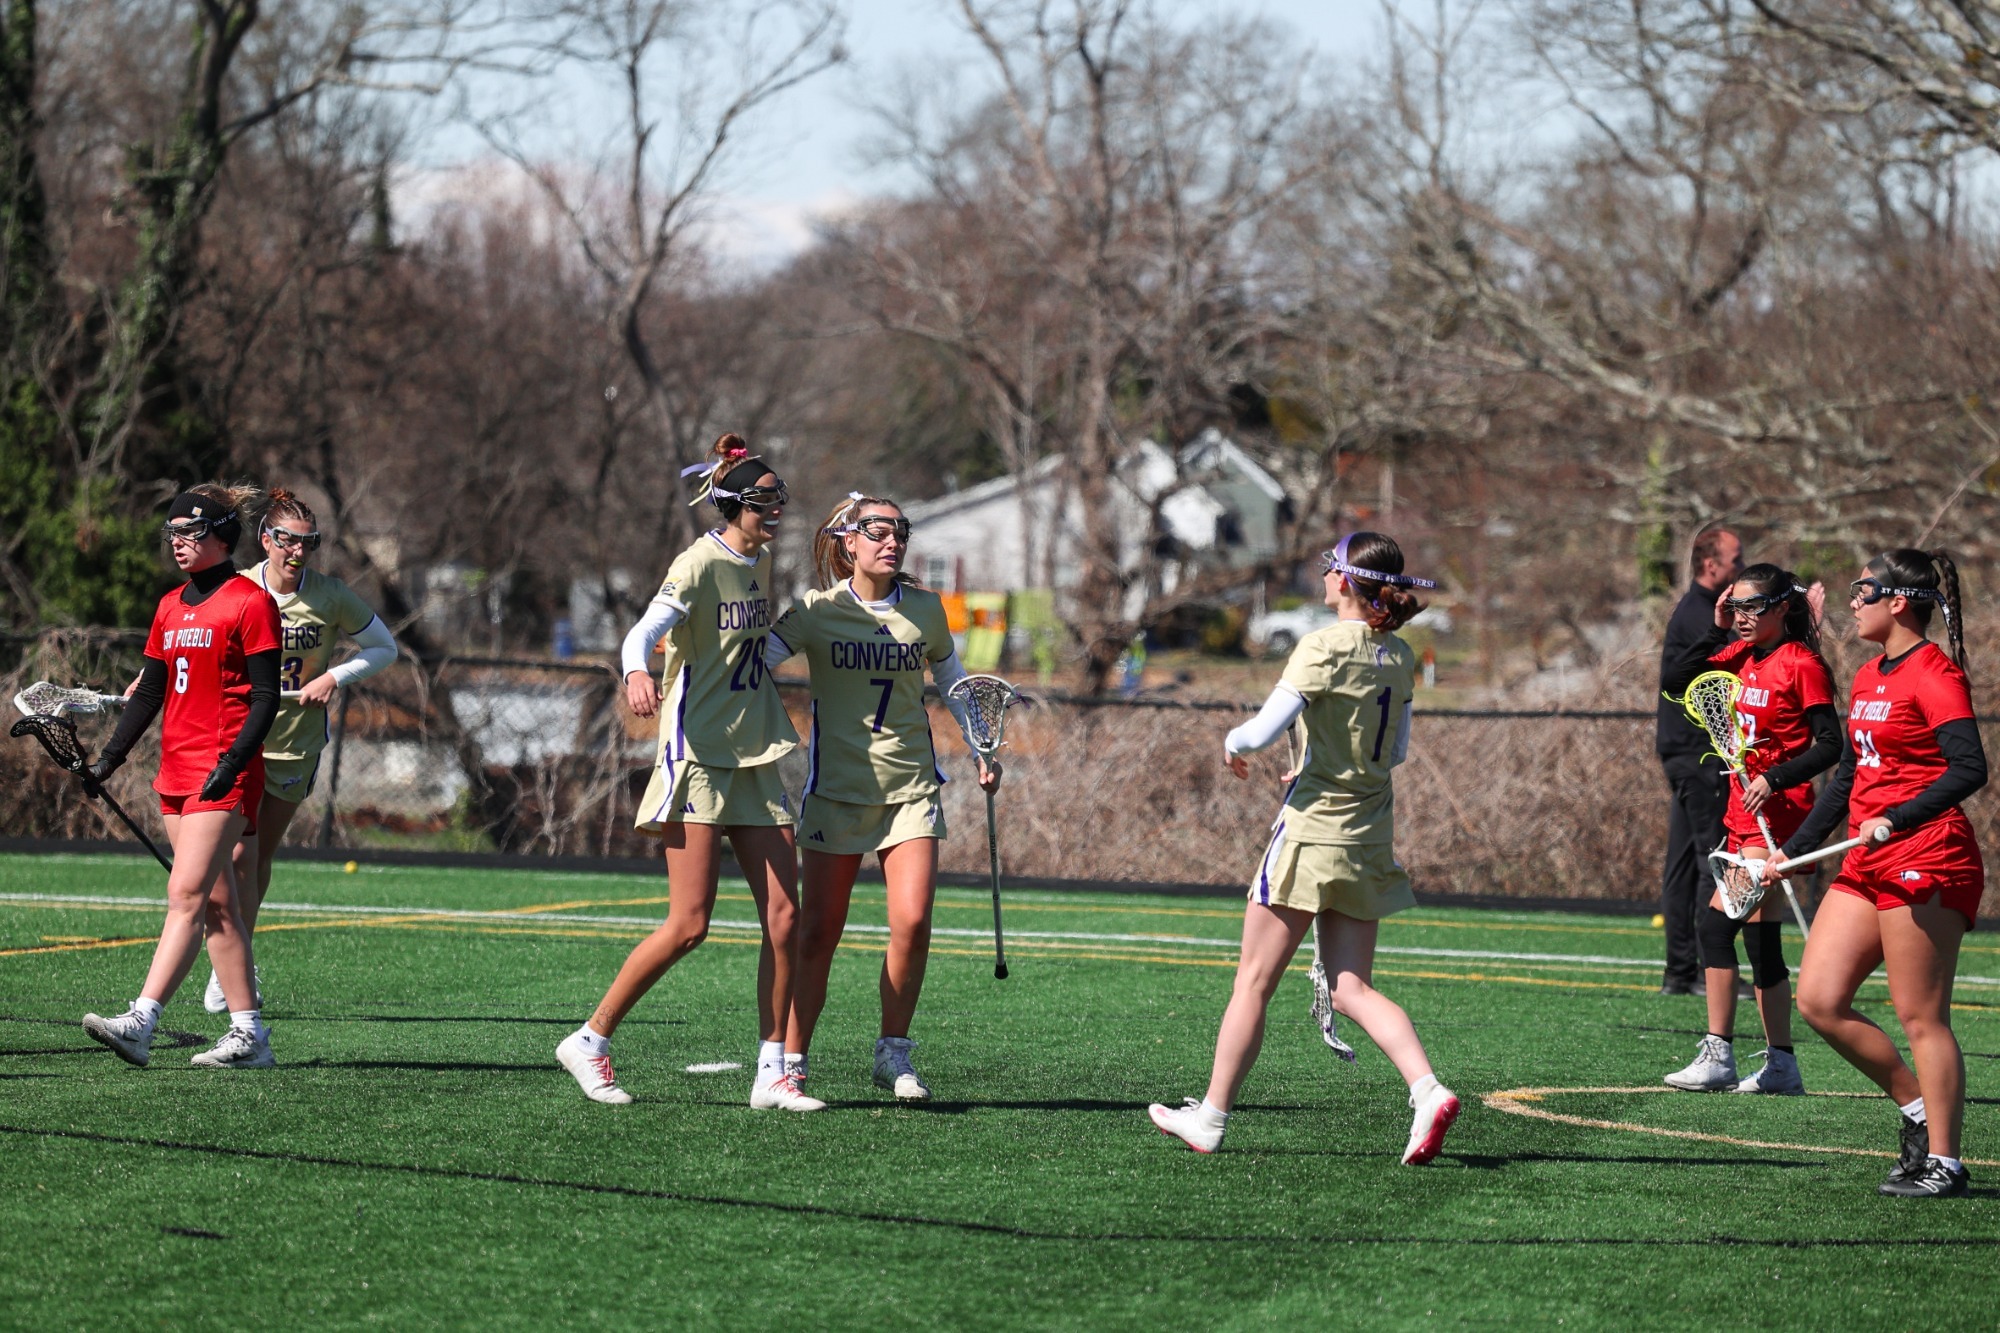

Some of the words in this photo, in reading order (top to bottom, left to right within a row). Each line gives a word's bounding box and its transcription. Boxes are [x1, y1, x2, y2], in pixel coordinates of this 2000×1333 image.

[1334, 562, 1383, 581] CONVERSE
[1894, 588, 1915, 597] GAIT
[175, 628, 213, 648] PUEBLO
[831, 641, 927, 671] CONVERSE
[175, 657, 189, 694] 6
[870, 679, 894, 733] 7
[1371, 687, 1391, 761] 1
[1855, 729, 1880, 768] 21
